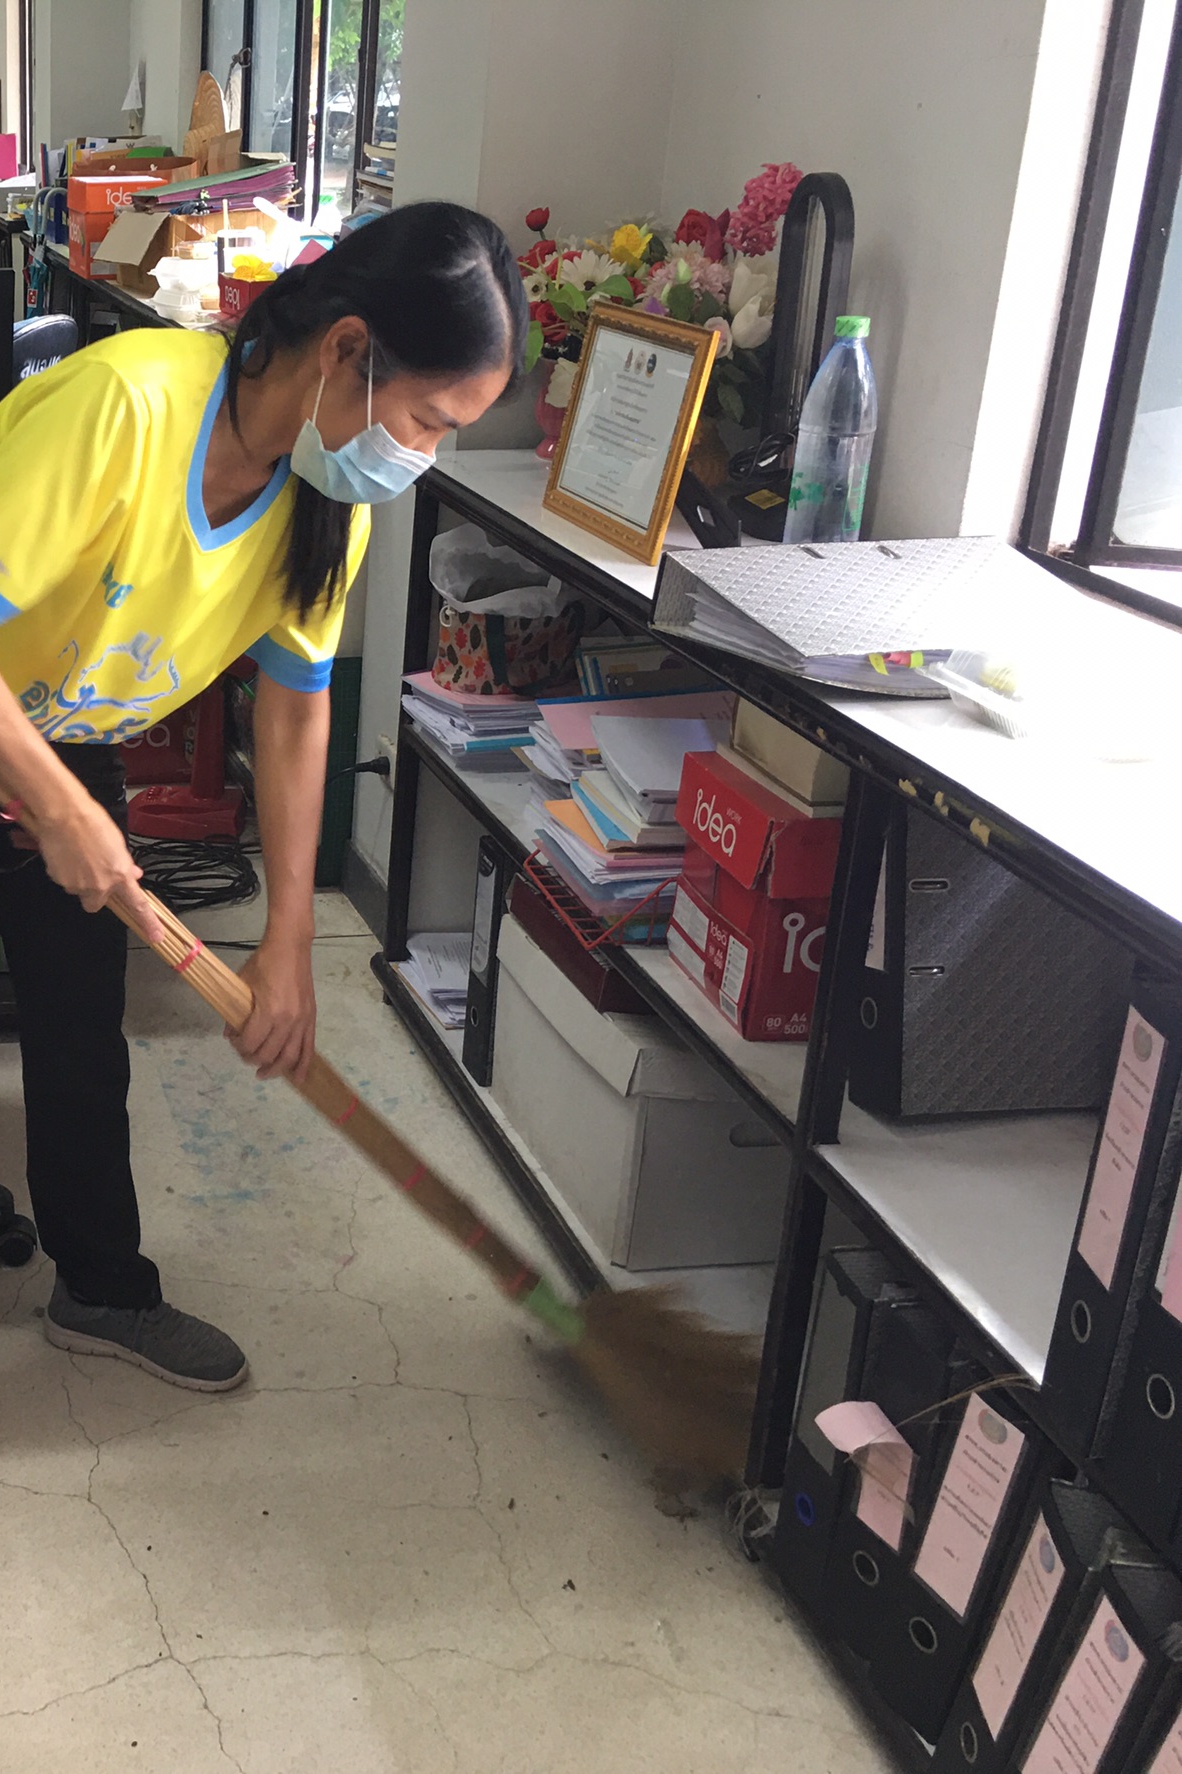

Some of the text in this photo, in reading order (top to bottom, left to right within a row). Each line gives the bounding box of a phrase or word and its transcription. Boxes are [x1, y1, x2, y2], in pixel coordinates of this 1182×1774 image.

[106, 186, 132, 207] ide
[693, 788, 737, 857] idea
[766, 1012, 808, 1028] 80 A4
[783, 1024, 806, 1035] 500
